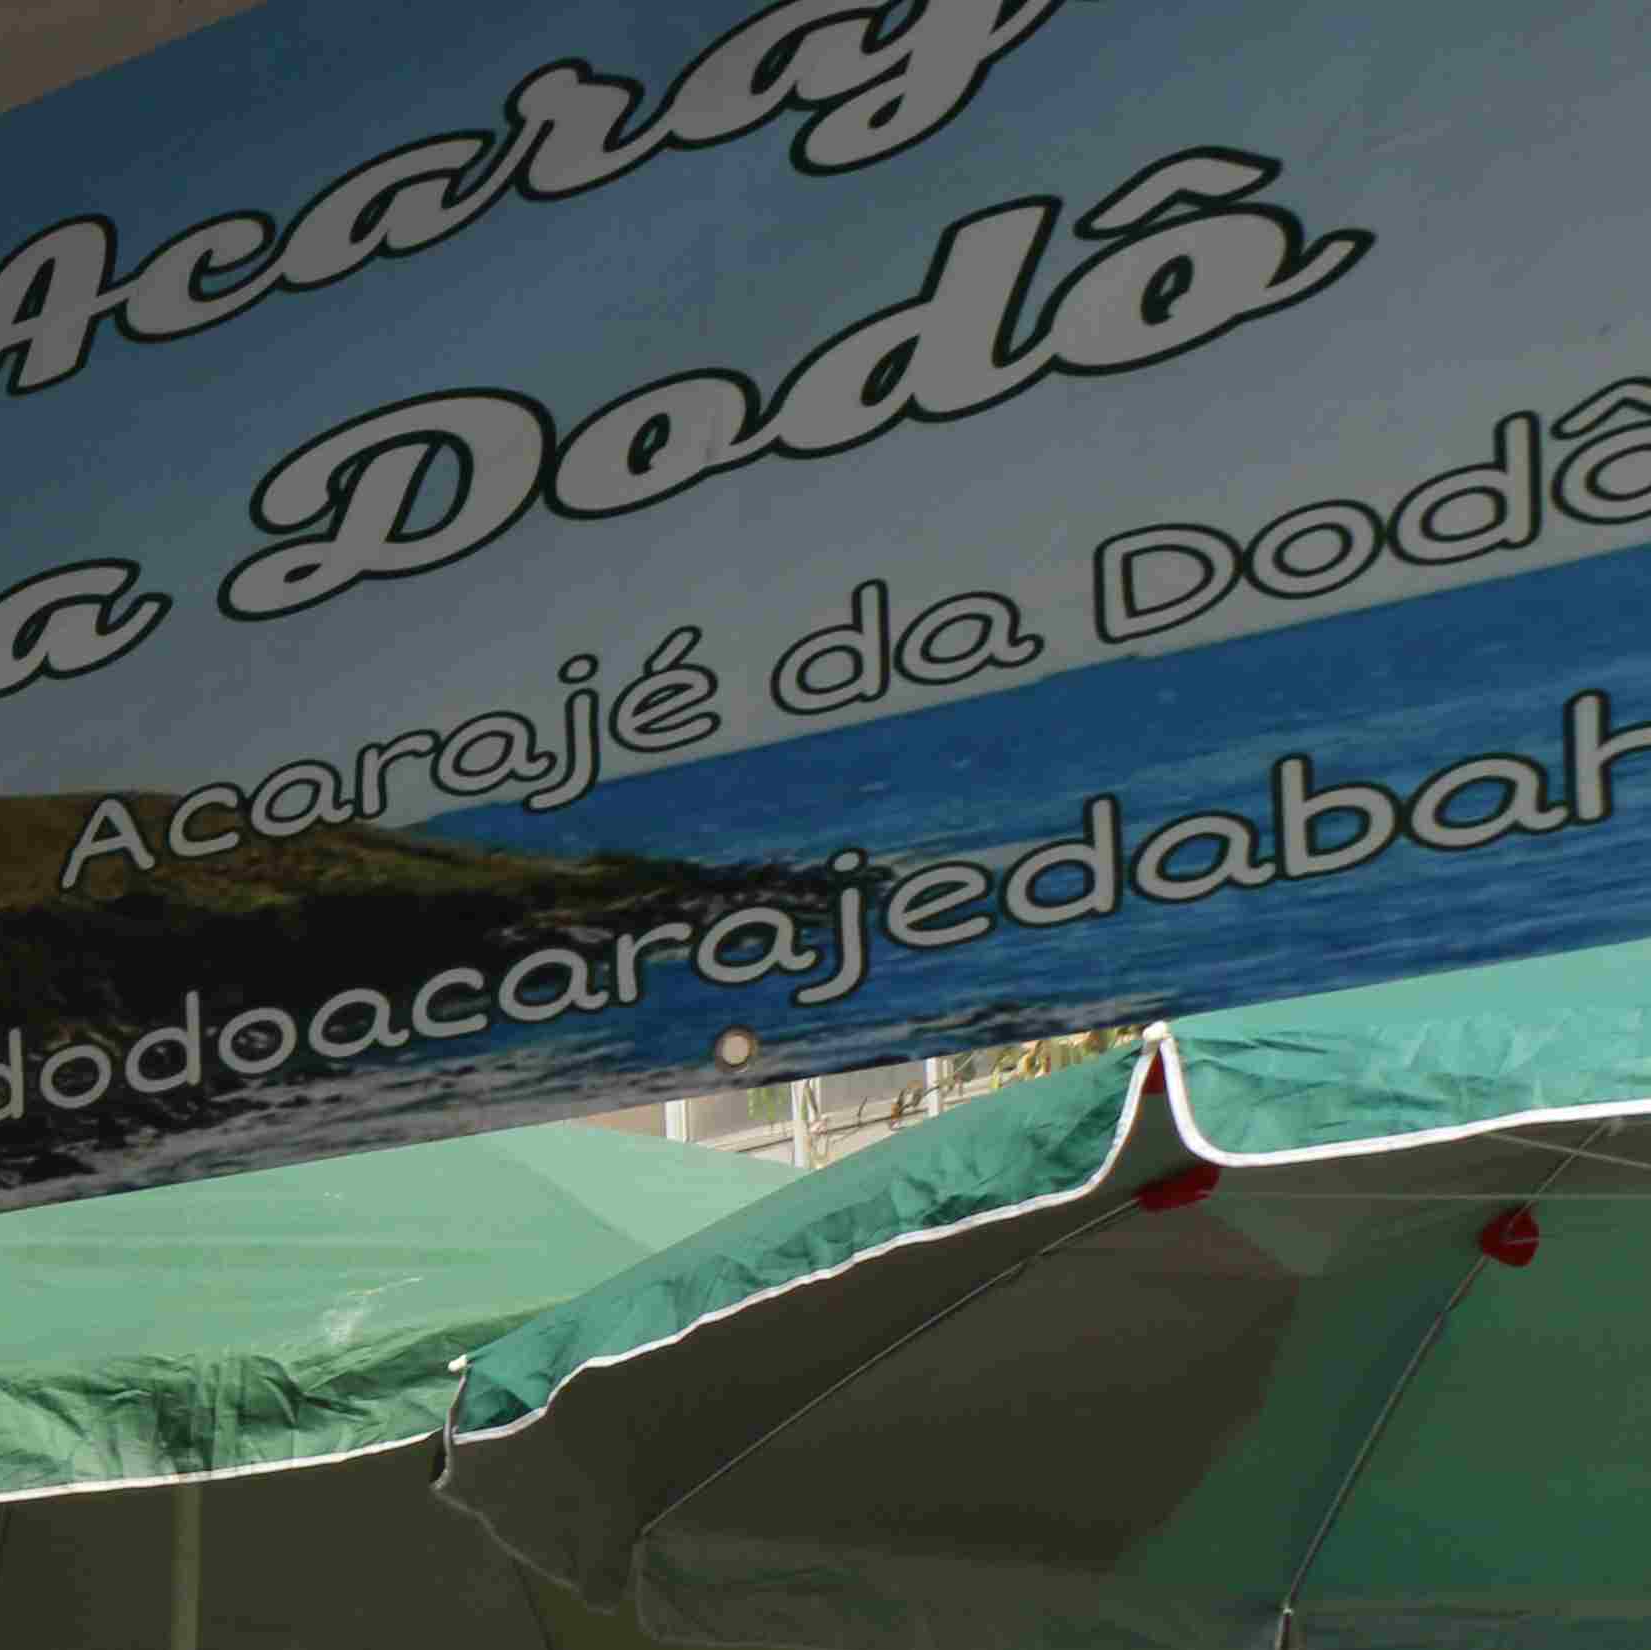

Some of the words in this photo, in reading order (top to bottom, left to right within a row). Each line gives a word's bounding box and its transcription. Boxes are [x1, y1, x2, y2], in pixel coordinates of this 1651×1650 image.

[217, 146, 1376, 622] Dodô
[60, 626, 720, 891] Acarajé
[770, 577, 1045, 716] da
[1093, 376, 1651, 645] Dodô
